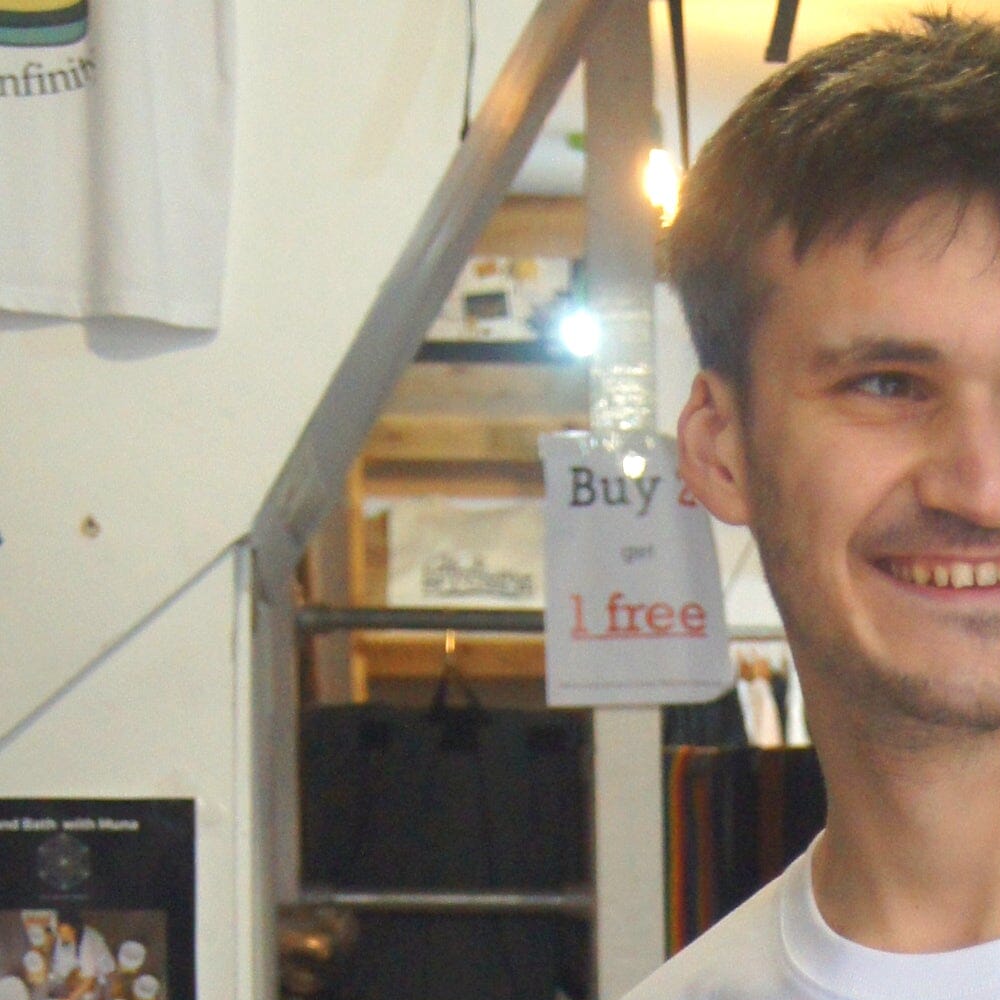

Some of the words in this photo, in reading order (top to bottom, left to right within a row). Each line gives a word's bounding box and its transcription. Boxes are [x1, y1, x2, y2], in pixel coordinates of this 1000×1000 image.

[570, 465, 660, 516] Buy
[570, 593, 589, 634] 1
[607, 591, 707, 635] free
